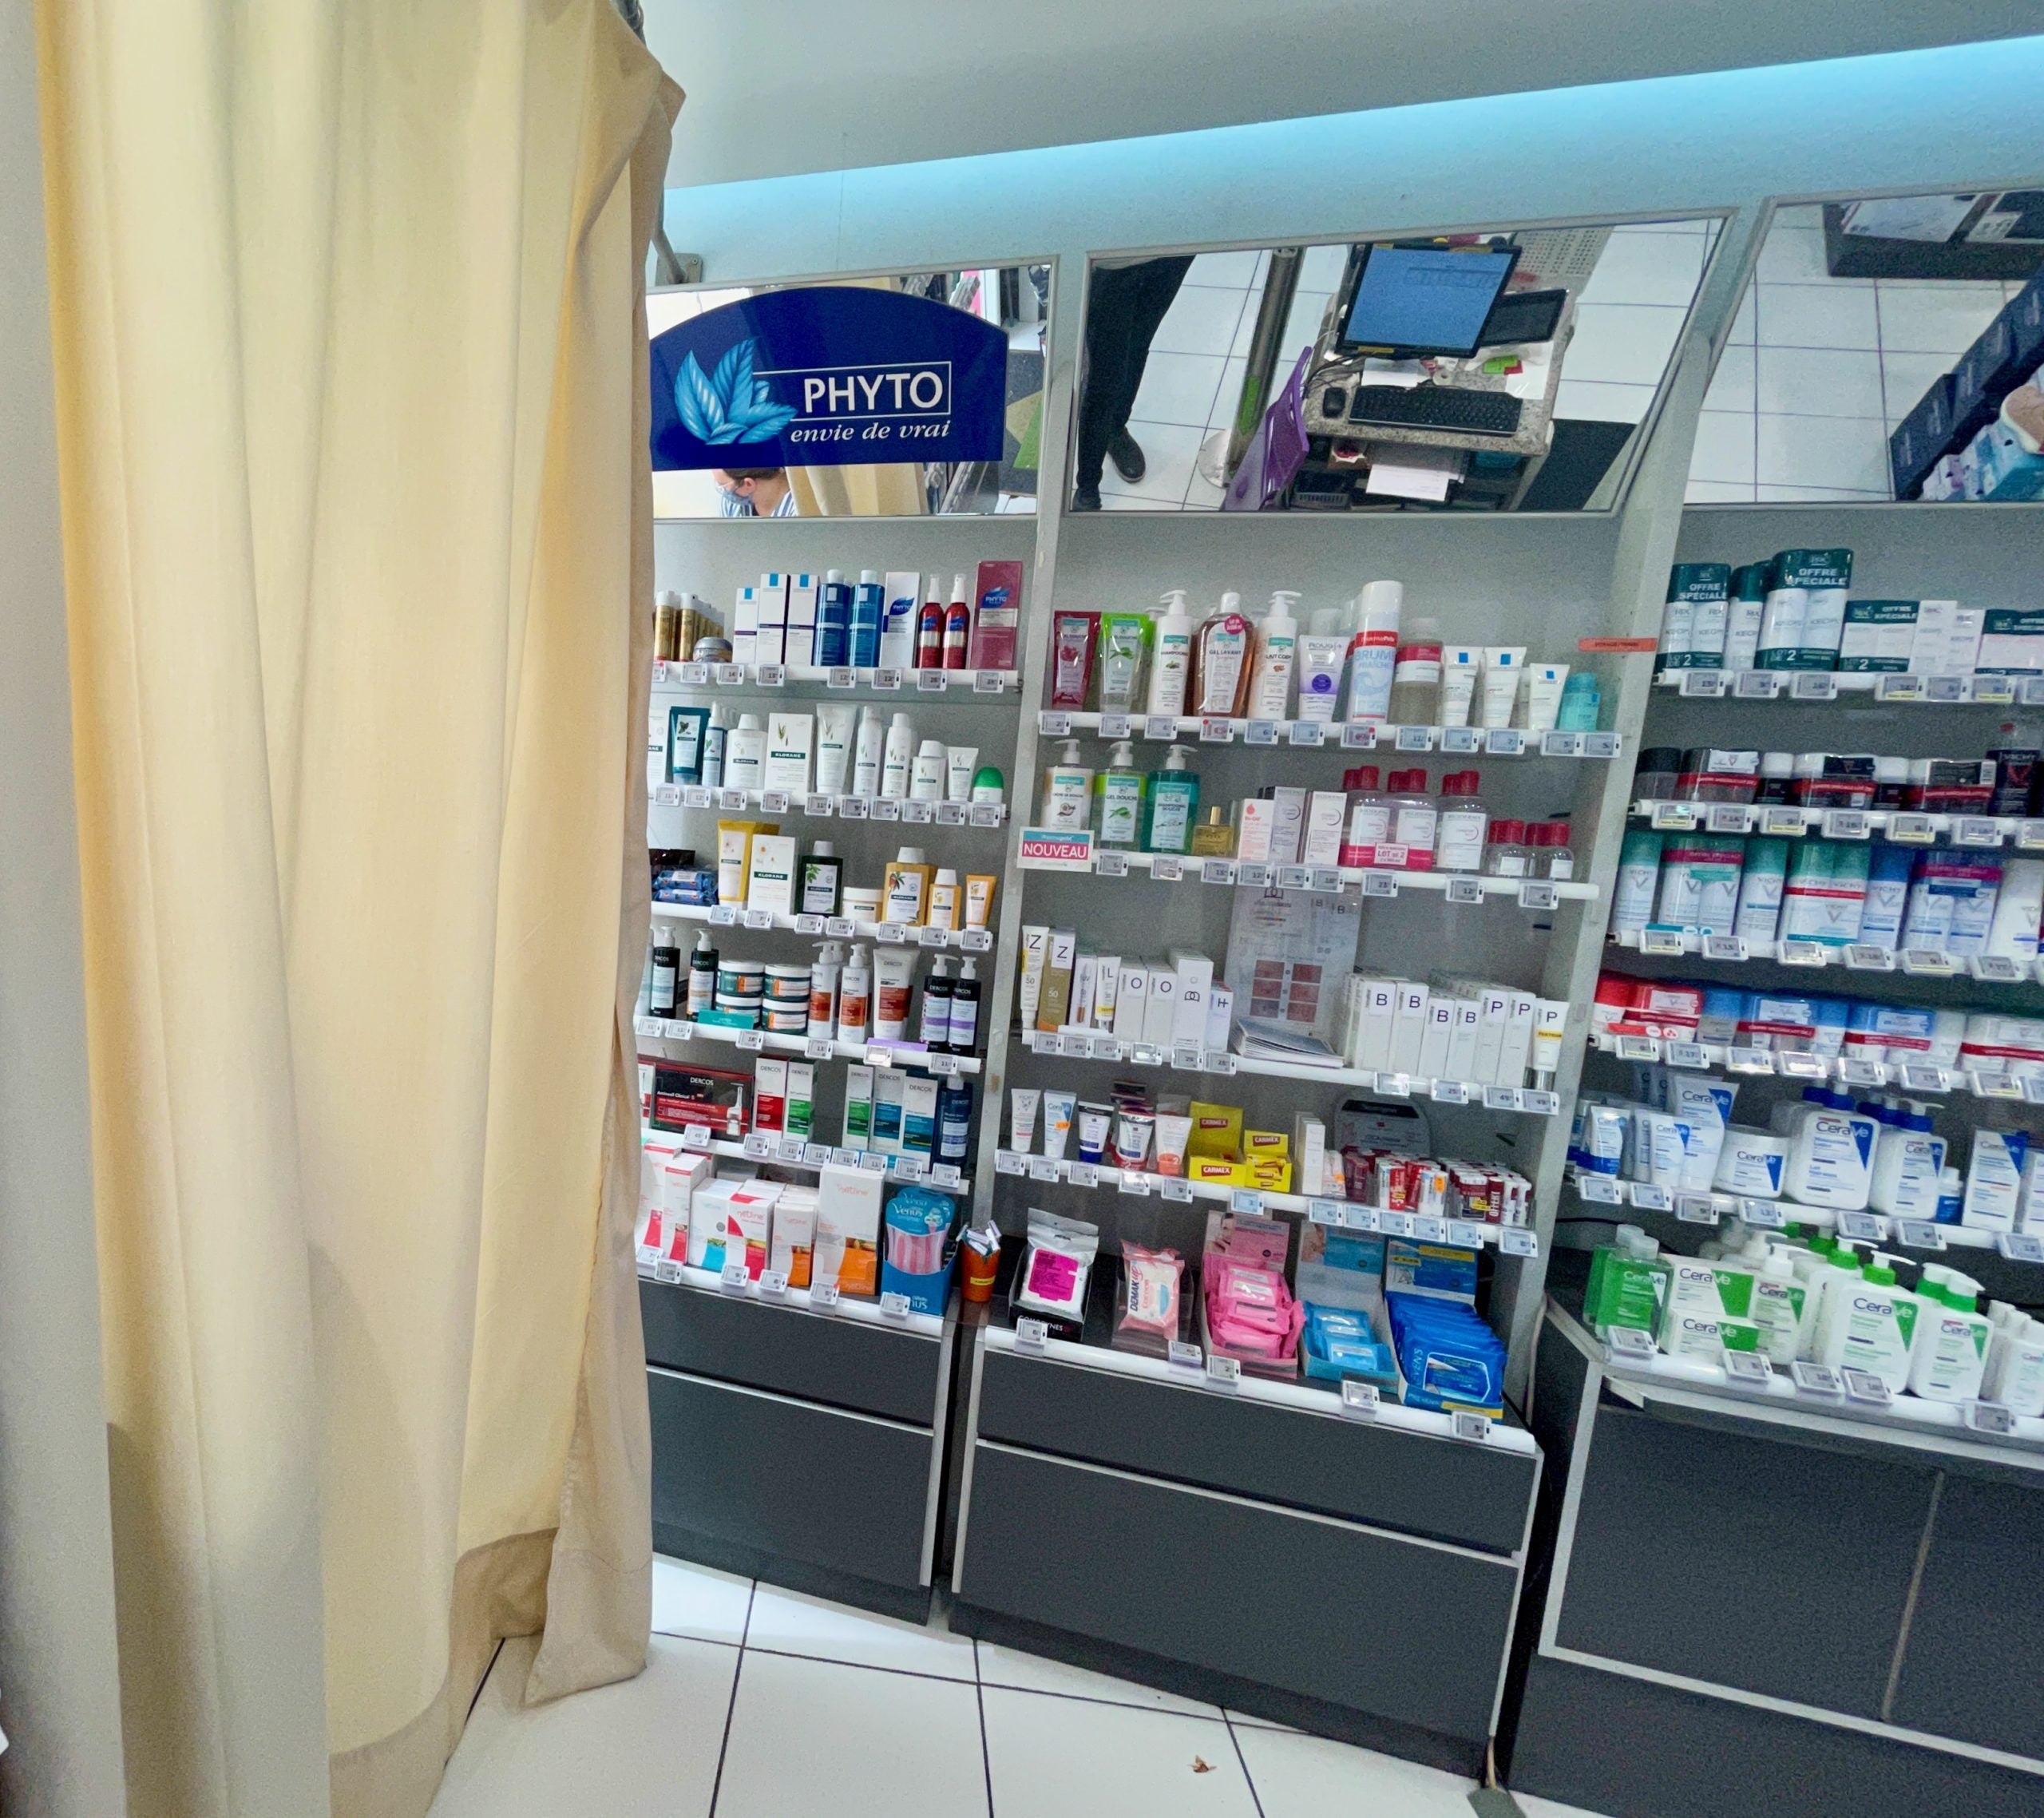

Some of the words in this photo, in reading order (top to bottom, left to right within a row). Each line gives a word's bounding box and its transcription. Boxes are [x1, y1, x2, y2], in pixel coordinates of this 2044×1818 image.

[804, 371, 943, 414] PHYTO
[790, 423, 854, 443] envie
[862, 422, 891, 440] de
[899, 420, 951, 438] vrai
[1799, 568, 1837, 576] OFFRE
[1683, 655, 1692, 666] 2
[1787, 650, 1796, 661] 2
[1859, 659, 1868, 670] 2
[1023, 843, 1087, 859] NOUVEAU
[1029, 934, 1041, 949] Z
[1057, 946, 1068, 959] Z
[1107, 968, 1113, 978] L
[1131, 977, 1142, 989] O
[1160, 981, 1171, 992] O
[1377, 993, 1388, 1006] B
[1409, 996, 1420, 1008] B
[1491, 1000, 1503, 1013] P
[1519, 1003, 1531, 1016] P
[1437, 1009, 1449, 1023] B
[1466, 1011, 1476, 1023] B
[1547, 1011, 1557, 1023] P
[690, 1077, 715, 1086] DERCOS
[909, 1083, 933, 1092] DERCOS
[1682, 1090, 1729, 1106] CeraVe
[1656, 1123, 1690, 1135] CeraVe
[1815, 1120, 1870, 1139] CeraVe
[1905, 1144, 1943, 1156] CeraVe
[1980, 1139, 2021, 1153] CeraVe
[1737, 1150, 1777, 1164] CeraVe
[892, 1202, 924, 1218] Venus
[1489, 1190, 1501, 1217] OFFERT
[1623, 1270, 1666, 1285] CeraVe
[1680, 1268, 1731, 1285] CeraVe
[1130, 1278, 1140, 1312] DEMAK
[1758, 1285, 1804, 1301] CeraVe
[1853, 1297, 1913, 1318] CeraVe
[1682, 1318, 1737, 1338] CeraVe
[1941, 1324, 1986, 1338] CeraVe
